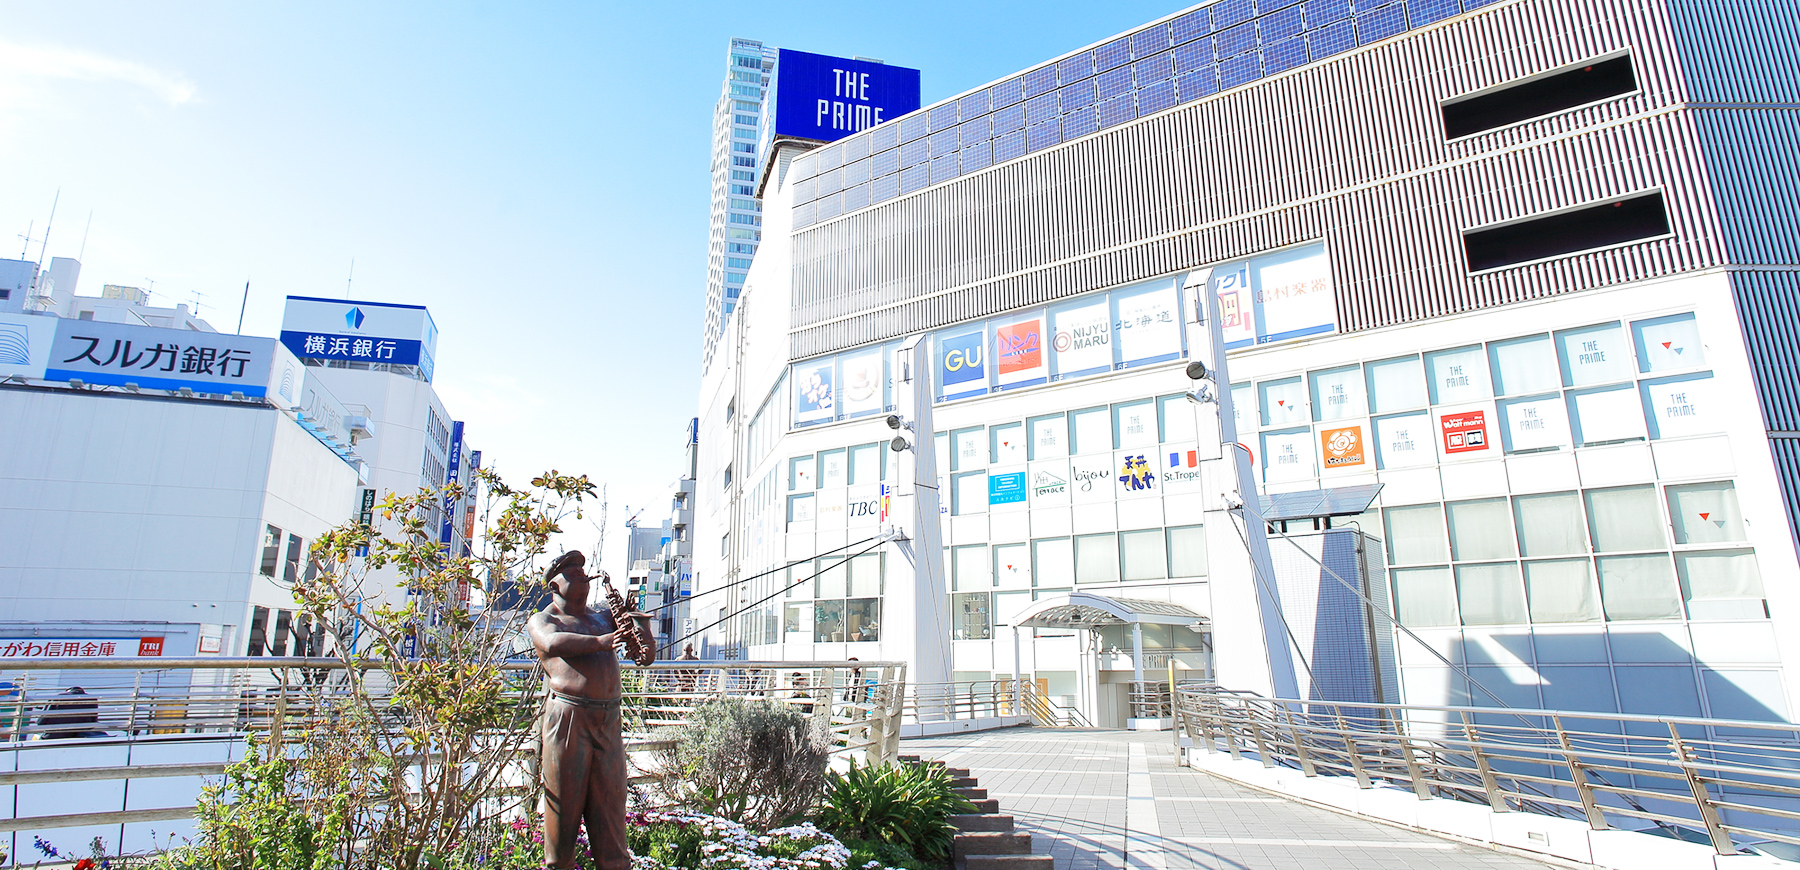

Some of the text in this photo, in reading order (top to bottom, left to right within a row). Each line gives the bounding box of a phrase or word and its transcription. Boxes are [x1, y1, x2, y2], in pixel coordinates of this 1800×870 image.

[833, 68, 870, 101] THE
[817, 99, 884, 132] PRIME
[1256, 277, 1326, 304] 島村楽器
[1115, 311, 1173, 331] 北海道
[1073, 322, 1108, 338] NIJYU
[303, 335, 397, 359] 横浜銀行
[1000, 331, 1038, 351] リンク
[1073, 334, 1109, 350] MARU
[1582, 340, 1598, 351] THE
[63, 335, 251, 378] スルガ銀行
[945, 345, 981, 372] GU
[1579, 351, 1606, 365] PRIME
[1449, 365, 1463, 376] THE
[1446, 375, 1469, 388] PRIME
[1331, 384, 1344, 394] THE
[1328, 394, 1348, 405] PRIME
[1670, 393, 1687, 404] THE
[1523, 408, 1537, 418] THE
[1667, 404, 1696, 418] PRIME
[1130, 415, 1140, 425] THE
[1520, 418, 1545, 430] PRIME
[1396, 430, 1409, 440] THE
[1281, 444, 1293, 453] THE
[1393, 440, 1415, 452] PRIME
[1278, 453, 1298, 464] PRIME
[1073, 466, 1109, 492] bijou
[1119, 471, 1155, 491] てんや
[849, 500, 878, 516] TBC
[0, 641, 117, 657] がわ信用金庫
[142, 642, 160, 650] TRI
